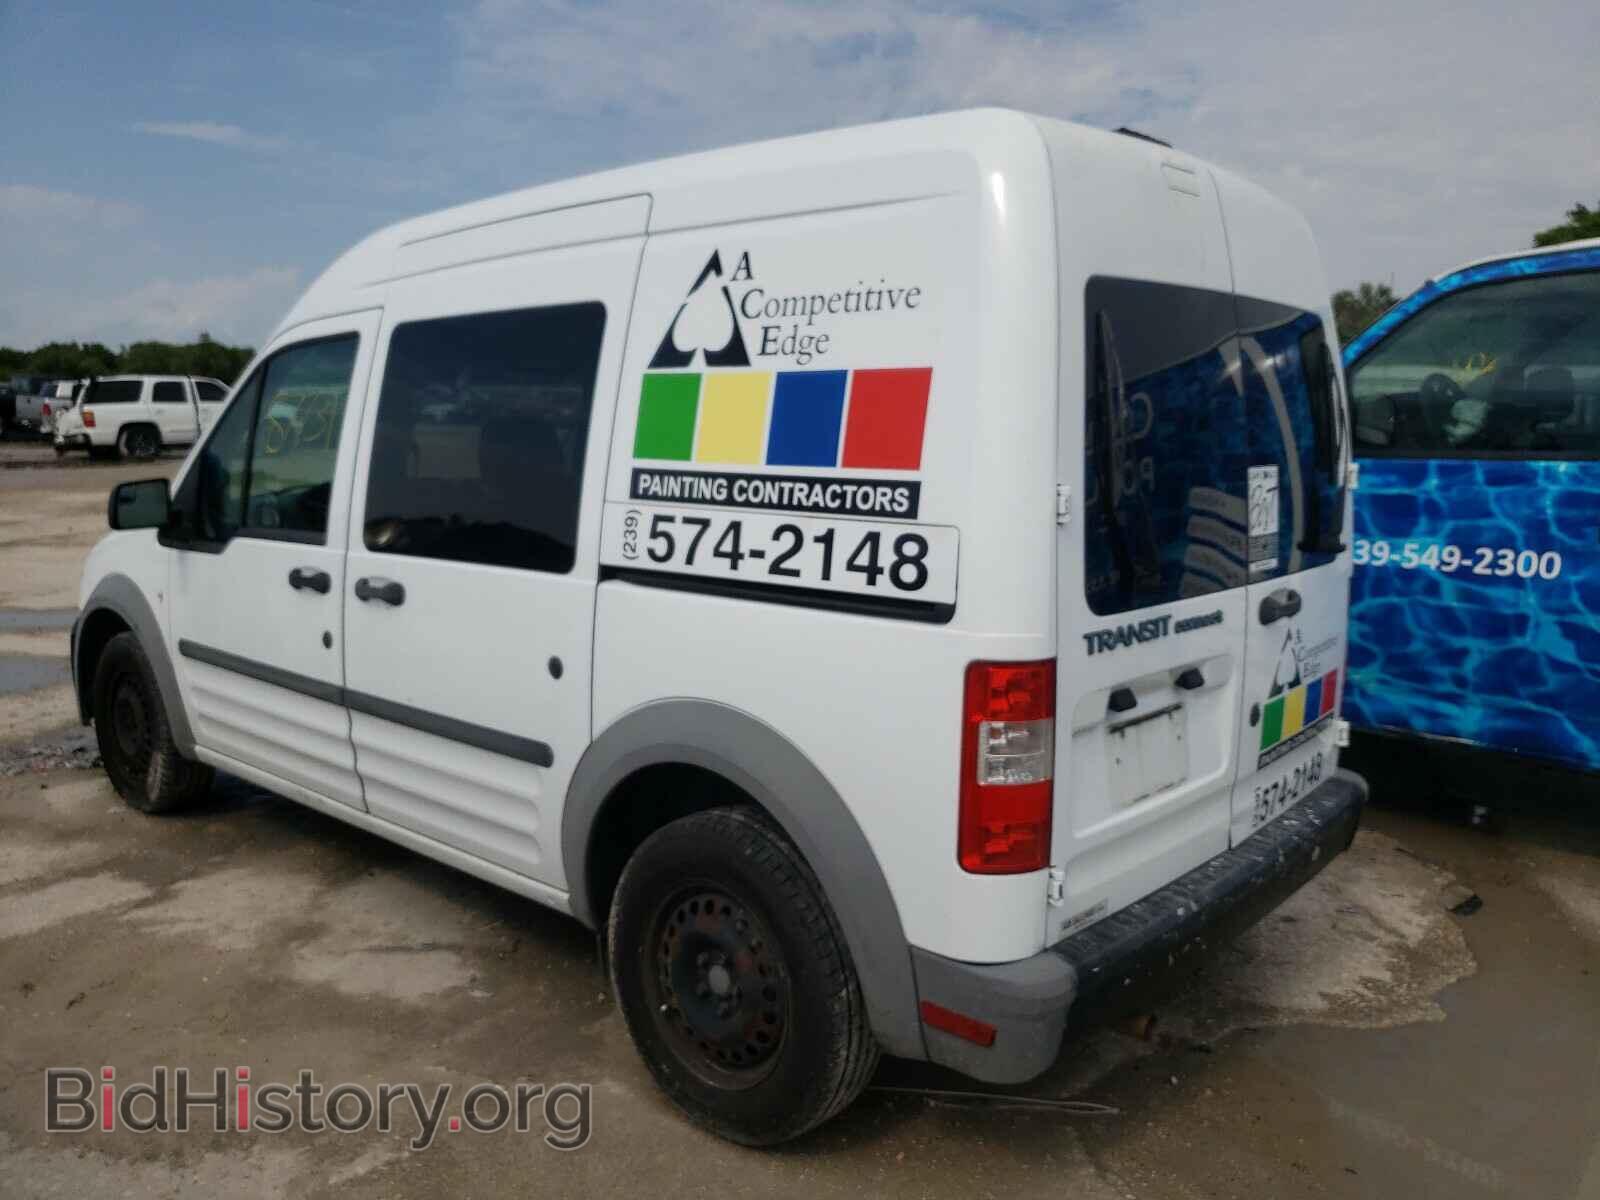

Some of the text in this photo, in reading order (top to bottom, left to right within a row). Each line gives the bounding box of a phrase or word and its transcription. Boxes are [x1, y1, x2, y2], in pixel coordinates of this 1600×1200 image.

[730, 250, 754, 282] A
[740, 277, 921, 326] Competitive
[757, 325, 830, 365] Edge
[638, 473, 910, 513] PAINTING CONTRACTORS
[622, 508, 929, 592] (239) 574-2148
[1352, 539, 1562, 579] 39-549-2300
[1083, 614, 1172, 656] TRANSIT
